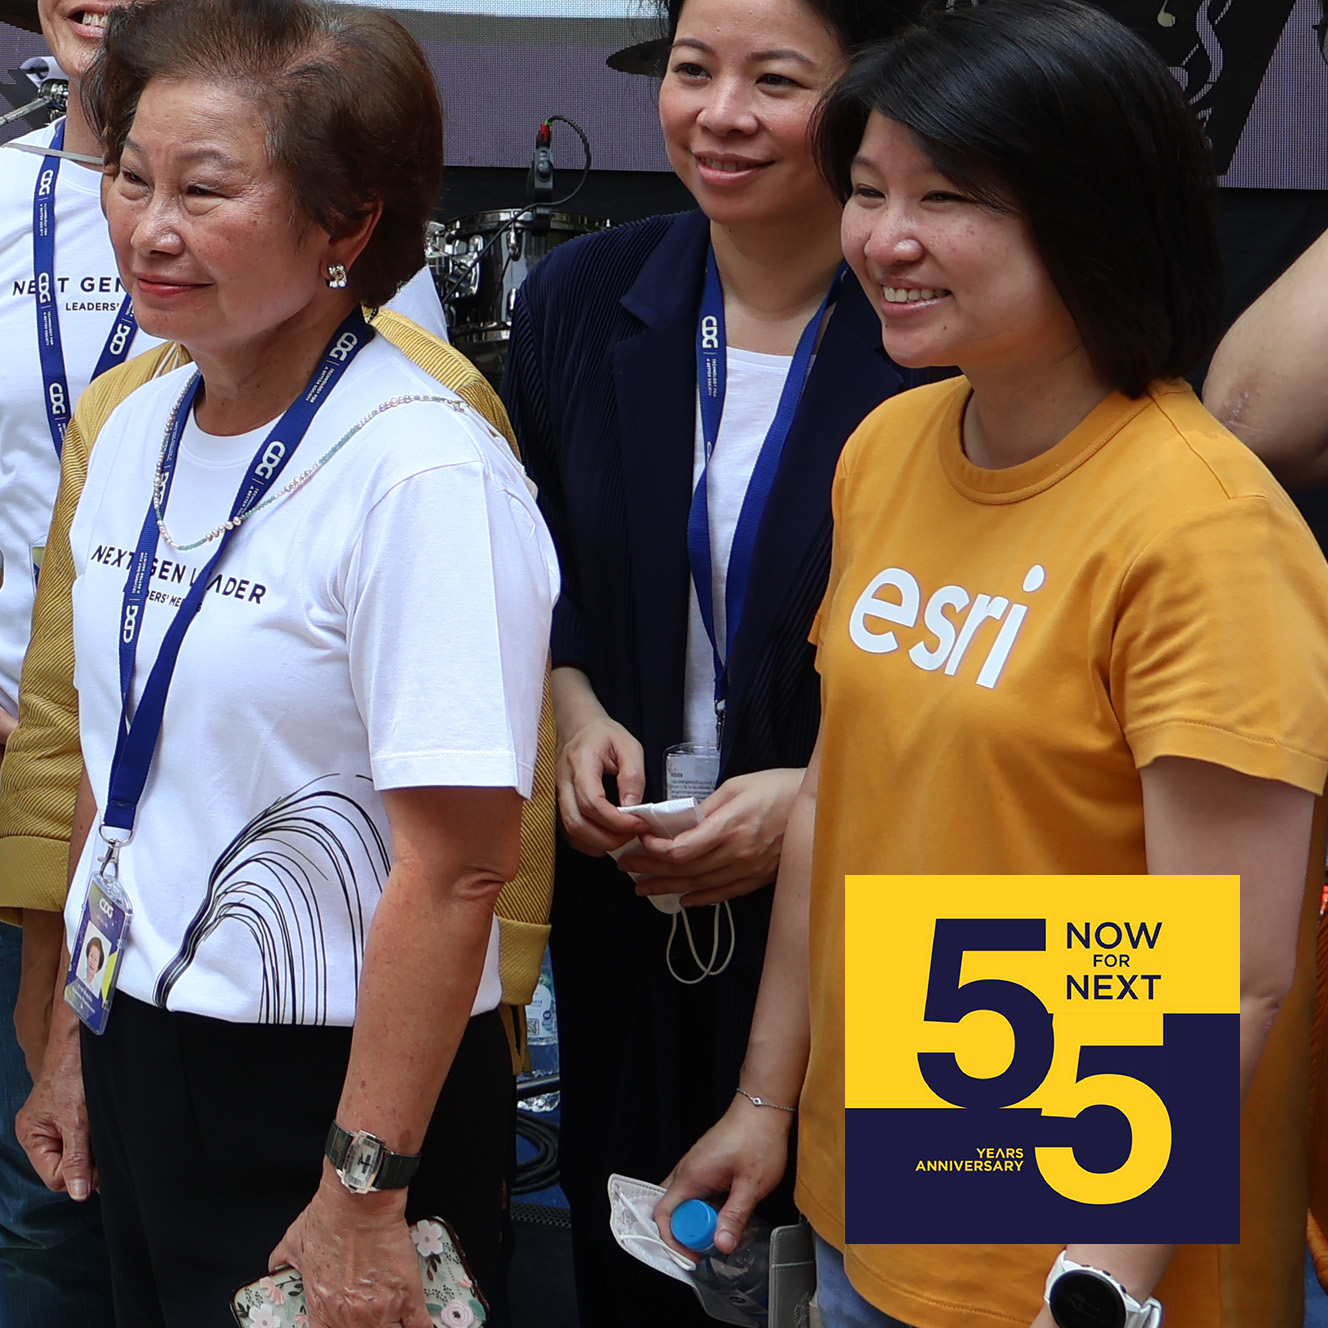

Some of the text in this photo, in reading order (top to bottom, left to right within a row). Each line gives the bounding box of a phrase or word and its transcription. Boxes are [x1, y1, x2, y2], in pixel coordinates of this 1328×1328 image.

[38, 169, 54, 196] CDG
[12, 277, 69, 296] NET
[38, 272, 51, 304] CDG
[65, 302, 120, 311] LEADERS'
[109, 323, 131, 355] CDG
[329, 332, 358, 362] CDG
[702, 315, 719, 349] CDG
[49, 382, 65, 415] CDG
[254, 440, 286, 480] CDG
[123, 605, 139, 644] CDG
[849, 564, 1045, 689] esri
[99, 897, 114, 919] CDG
